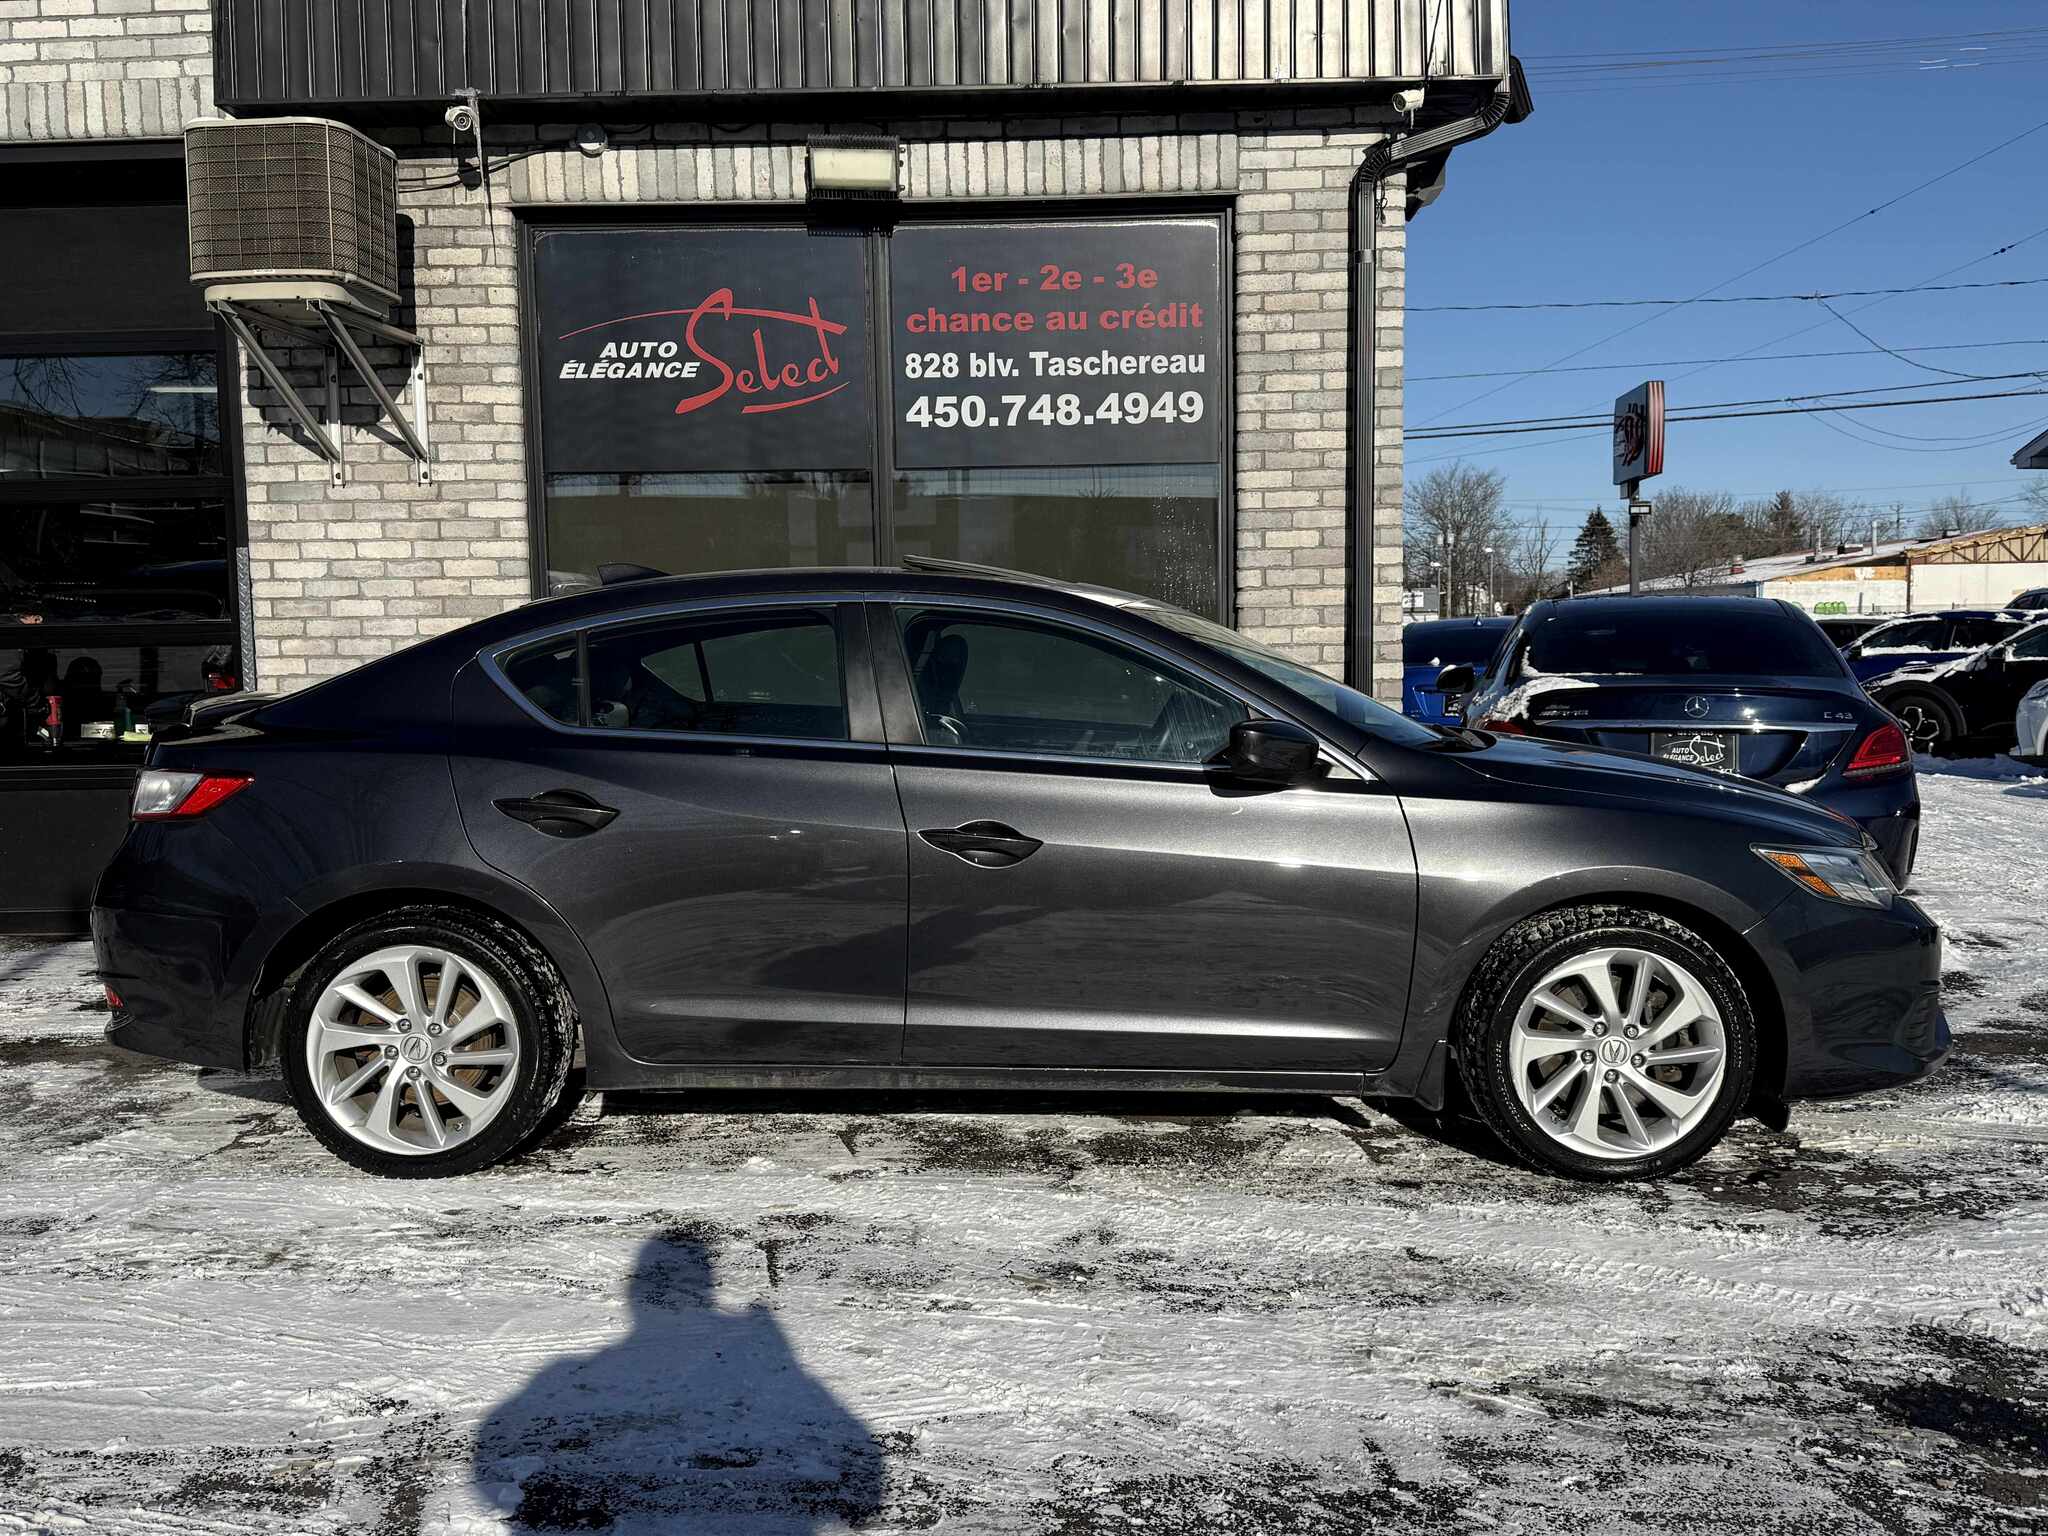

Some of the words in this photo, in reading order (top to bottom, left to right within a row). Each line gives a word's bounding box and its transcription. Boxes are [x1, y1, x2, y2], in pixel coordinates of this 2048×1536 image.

[951, 266, 1009, 293] 1er
[1039, 264, 1082, 291] 2e
[1115, 262, 1159, 289] 3e
[905, 307, 1036, 334] chance
[1046, 311, 1088, 333] au
[1099, 302, 1204, 331] crédit
[600, 341, 678, 359] AUTO
[674, 287, 848, 415] Select
[905, 352, 960, 379] 828
[969, 352, 1020, 378] blv.
[1029, 350, 1206, 377] Taschereau
[559, 360, 700, 380] ÉLÉGANCE
[905, 391, 1204, 428] 450.748.4949
